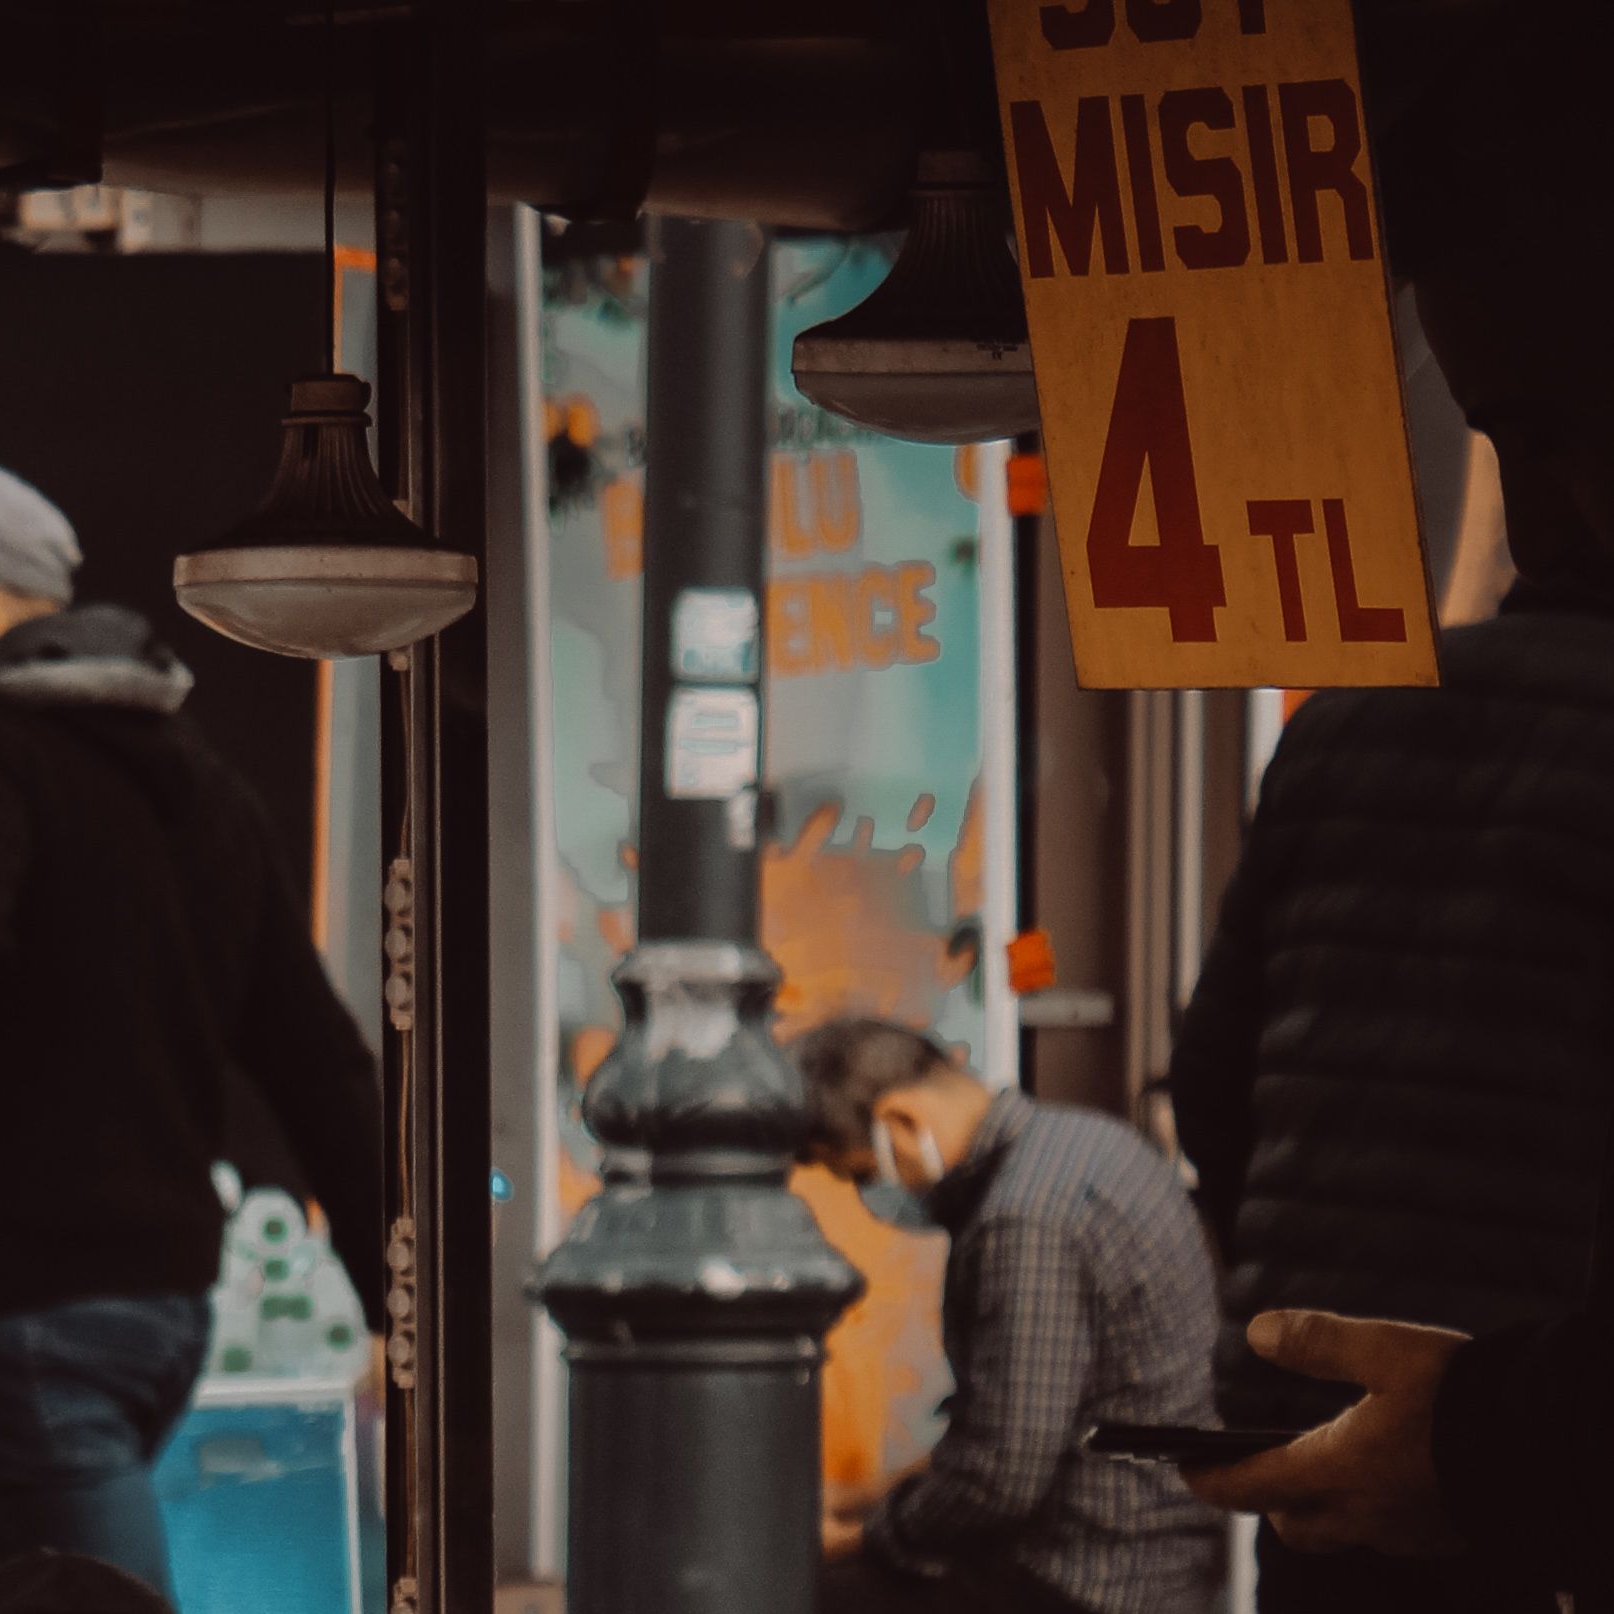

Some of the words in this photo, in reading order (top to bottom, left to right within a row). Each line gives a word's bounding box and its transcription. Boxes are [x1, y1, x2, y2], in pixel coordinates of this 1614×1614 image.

[1010, 78, 1374, 279] MISIR
[1086, 316, 1227, 643] 4
[1246, 498, 1407, 643] TL
